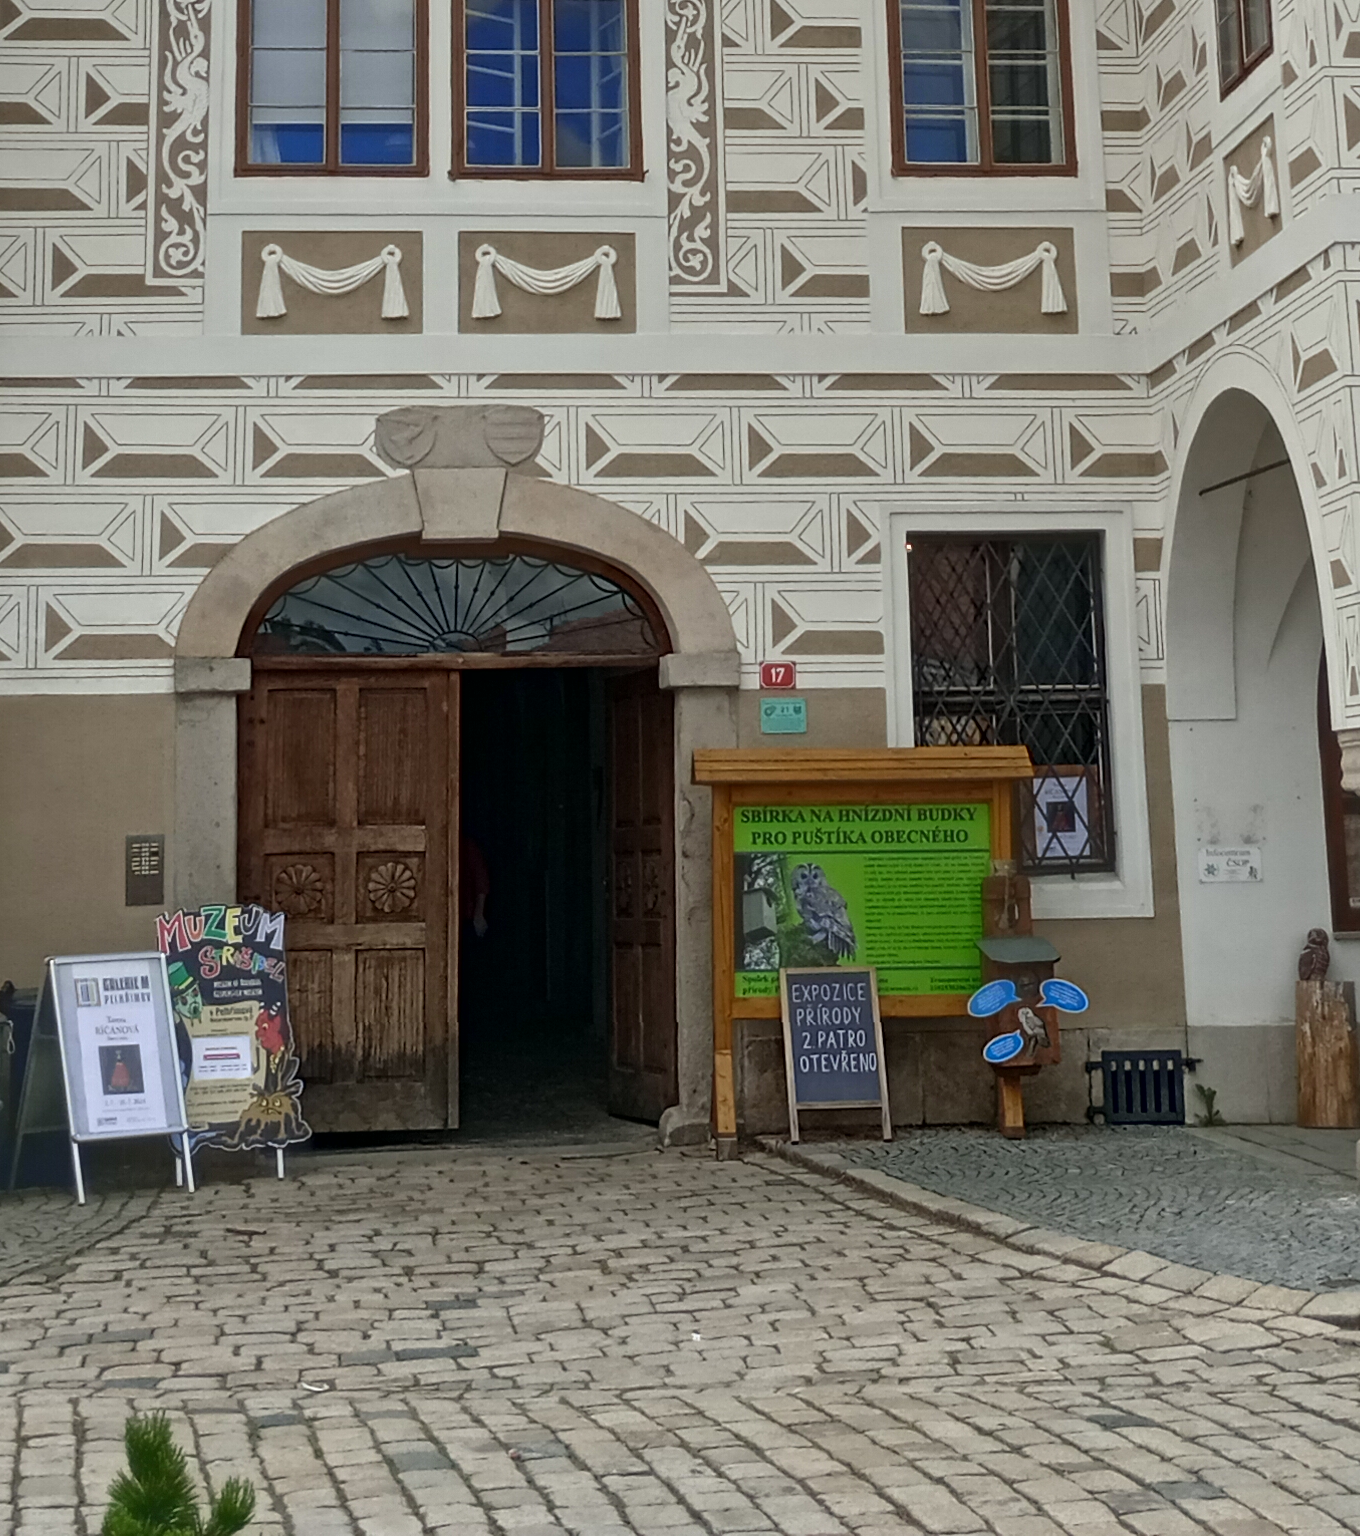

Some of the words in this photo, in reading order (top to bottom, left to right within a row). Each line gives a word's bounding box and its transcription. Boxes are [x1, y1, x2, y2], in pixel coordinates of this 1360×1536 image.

[771, 667, 785, 683] 17
[741, 806, 806, 824] SBÍRKA
[810, 809, 835, 823] NA
[838, 805, 913, 823] HNÍZDNÍ
[917, 807, 978, 822] BUDKY
[751, 831, 788, 845] PRO
[791, 827, 867, 845] PUŠTÍKA
[870, 826, 969, 844] OBECNÉHO
[155, 904, 285, 955] MUZEUM
[198, 945, 286, 983] STRAŠIDEL
[792, 982, 867, 1003] EXPOZICE
[796, 1004, 861, 1026] PŘÍRODY
[799, 1050, 877, 1073] OTEVŘENO
